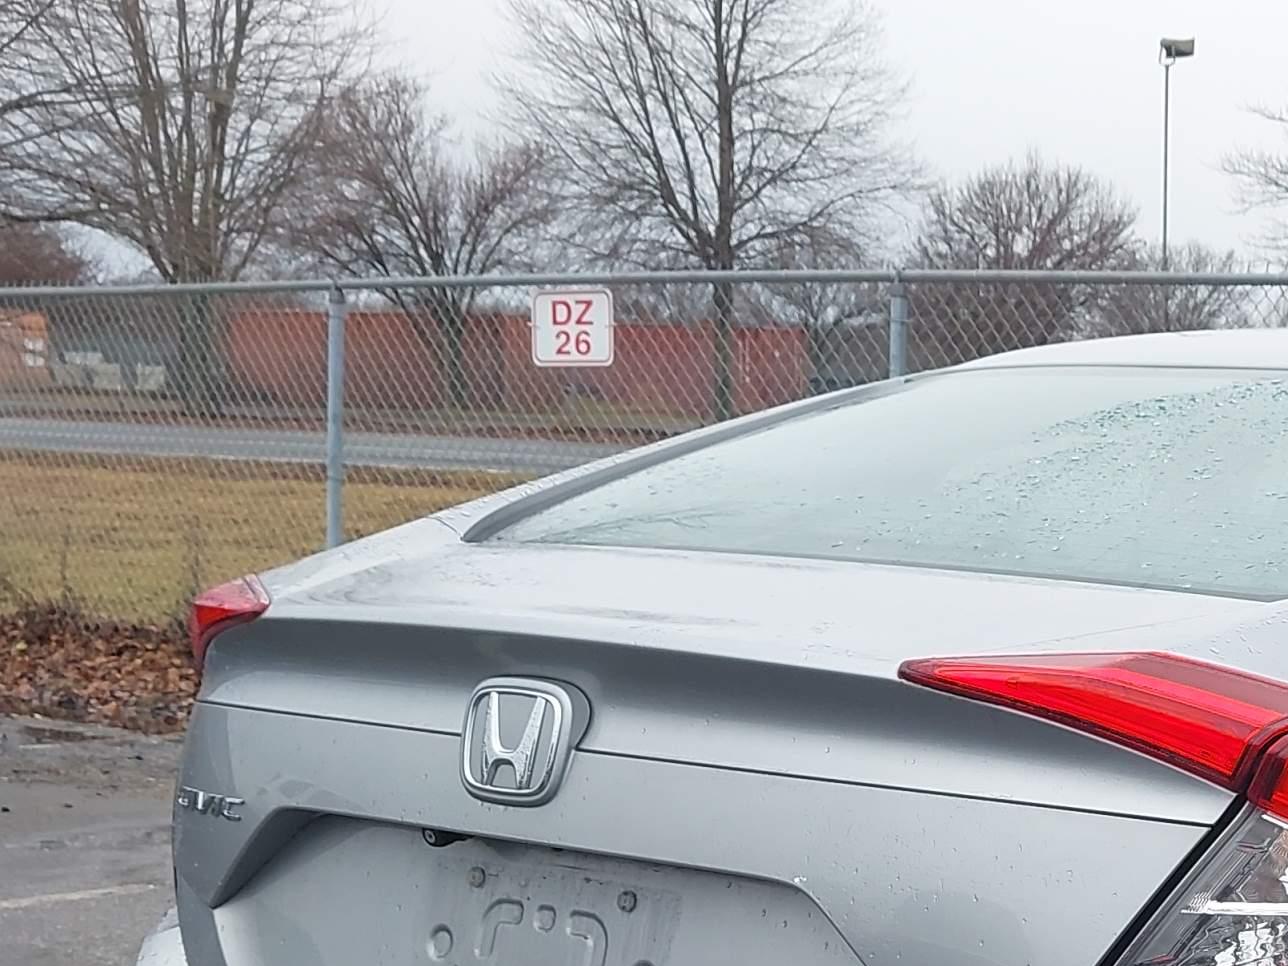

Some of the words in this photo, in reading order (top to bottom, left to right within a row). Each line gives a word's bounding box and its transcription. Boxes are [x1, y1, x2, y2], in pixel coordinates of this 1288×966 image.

[551, 300, 594, 326] DZ
[555, 330, 591, 356] 26
[178, 785, 245, 821] CIVIC
